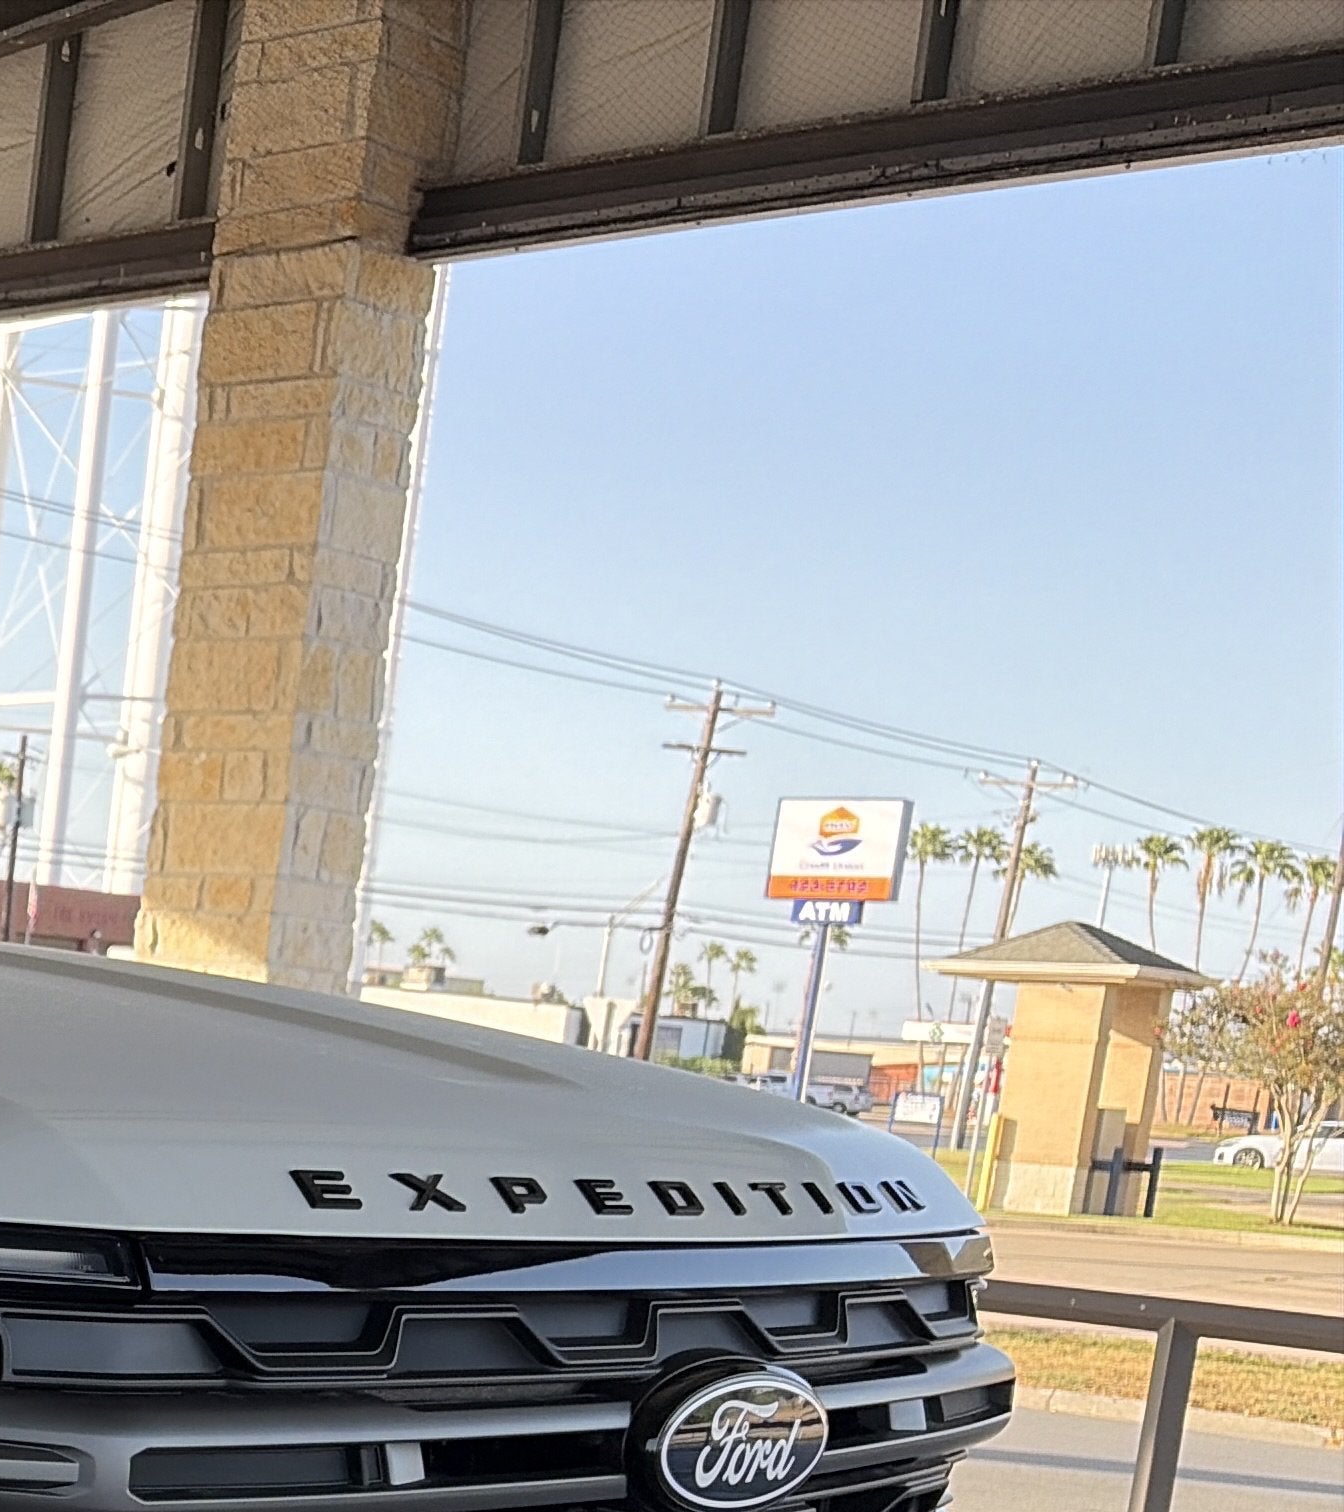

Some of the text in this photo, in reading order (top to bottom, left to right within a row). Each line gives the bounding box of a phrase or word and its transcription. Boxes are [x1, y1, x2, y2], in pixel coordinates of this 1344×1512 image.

[798, 901, 851, 922] ATM
[288, 1169, 928, 1217] EXPEDITION
[694, 1397, 803, 1489] Ford
